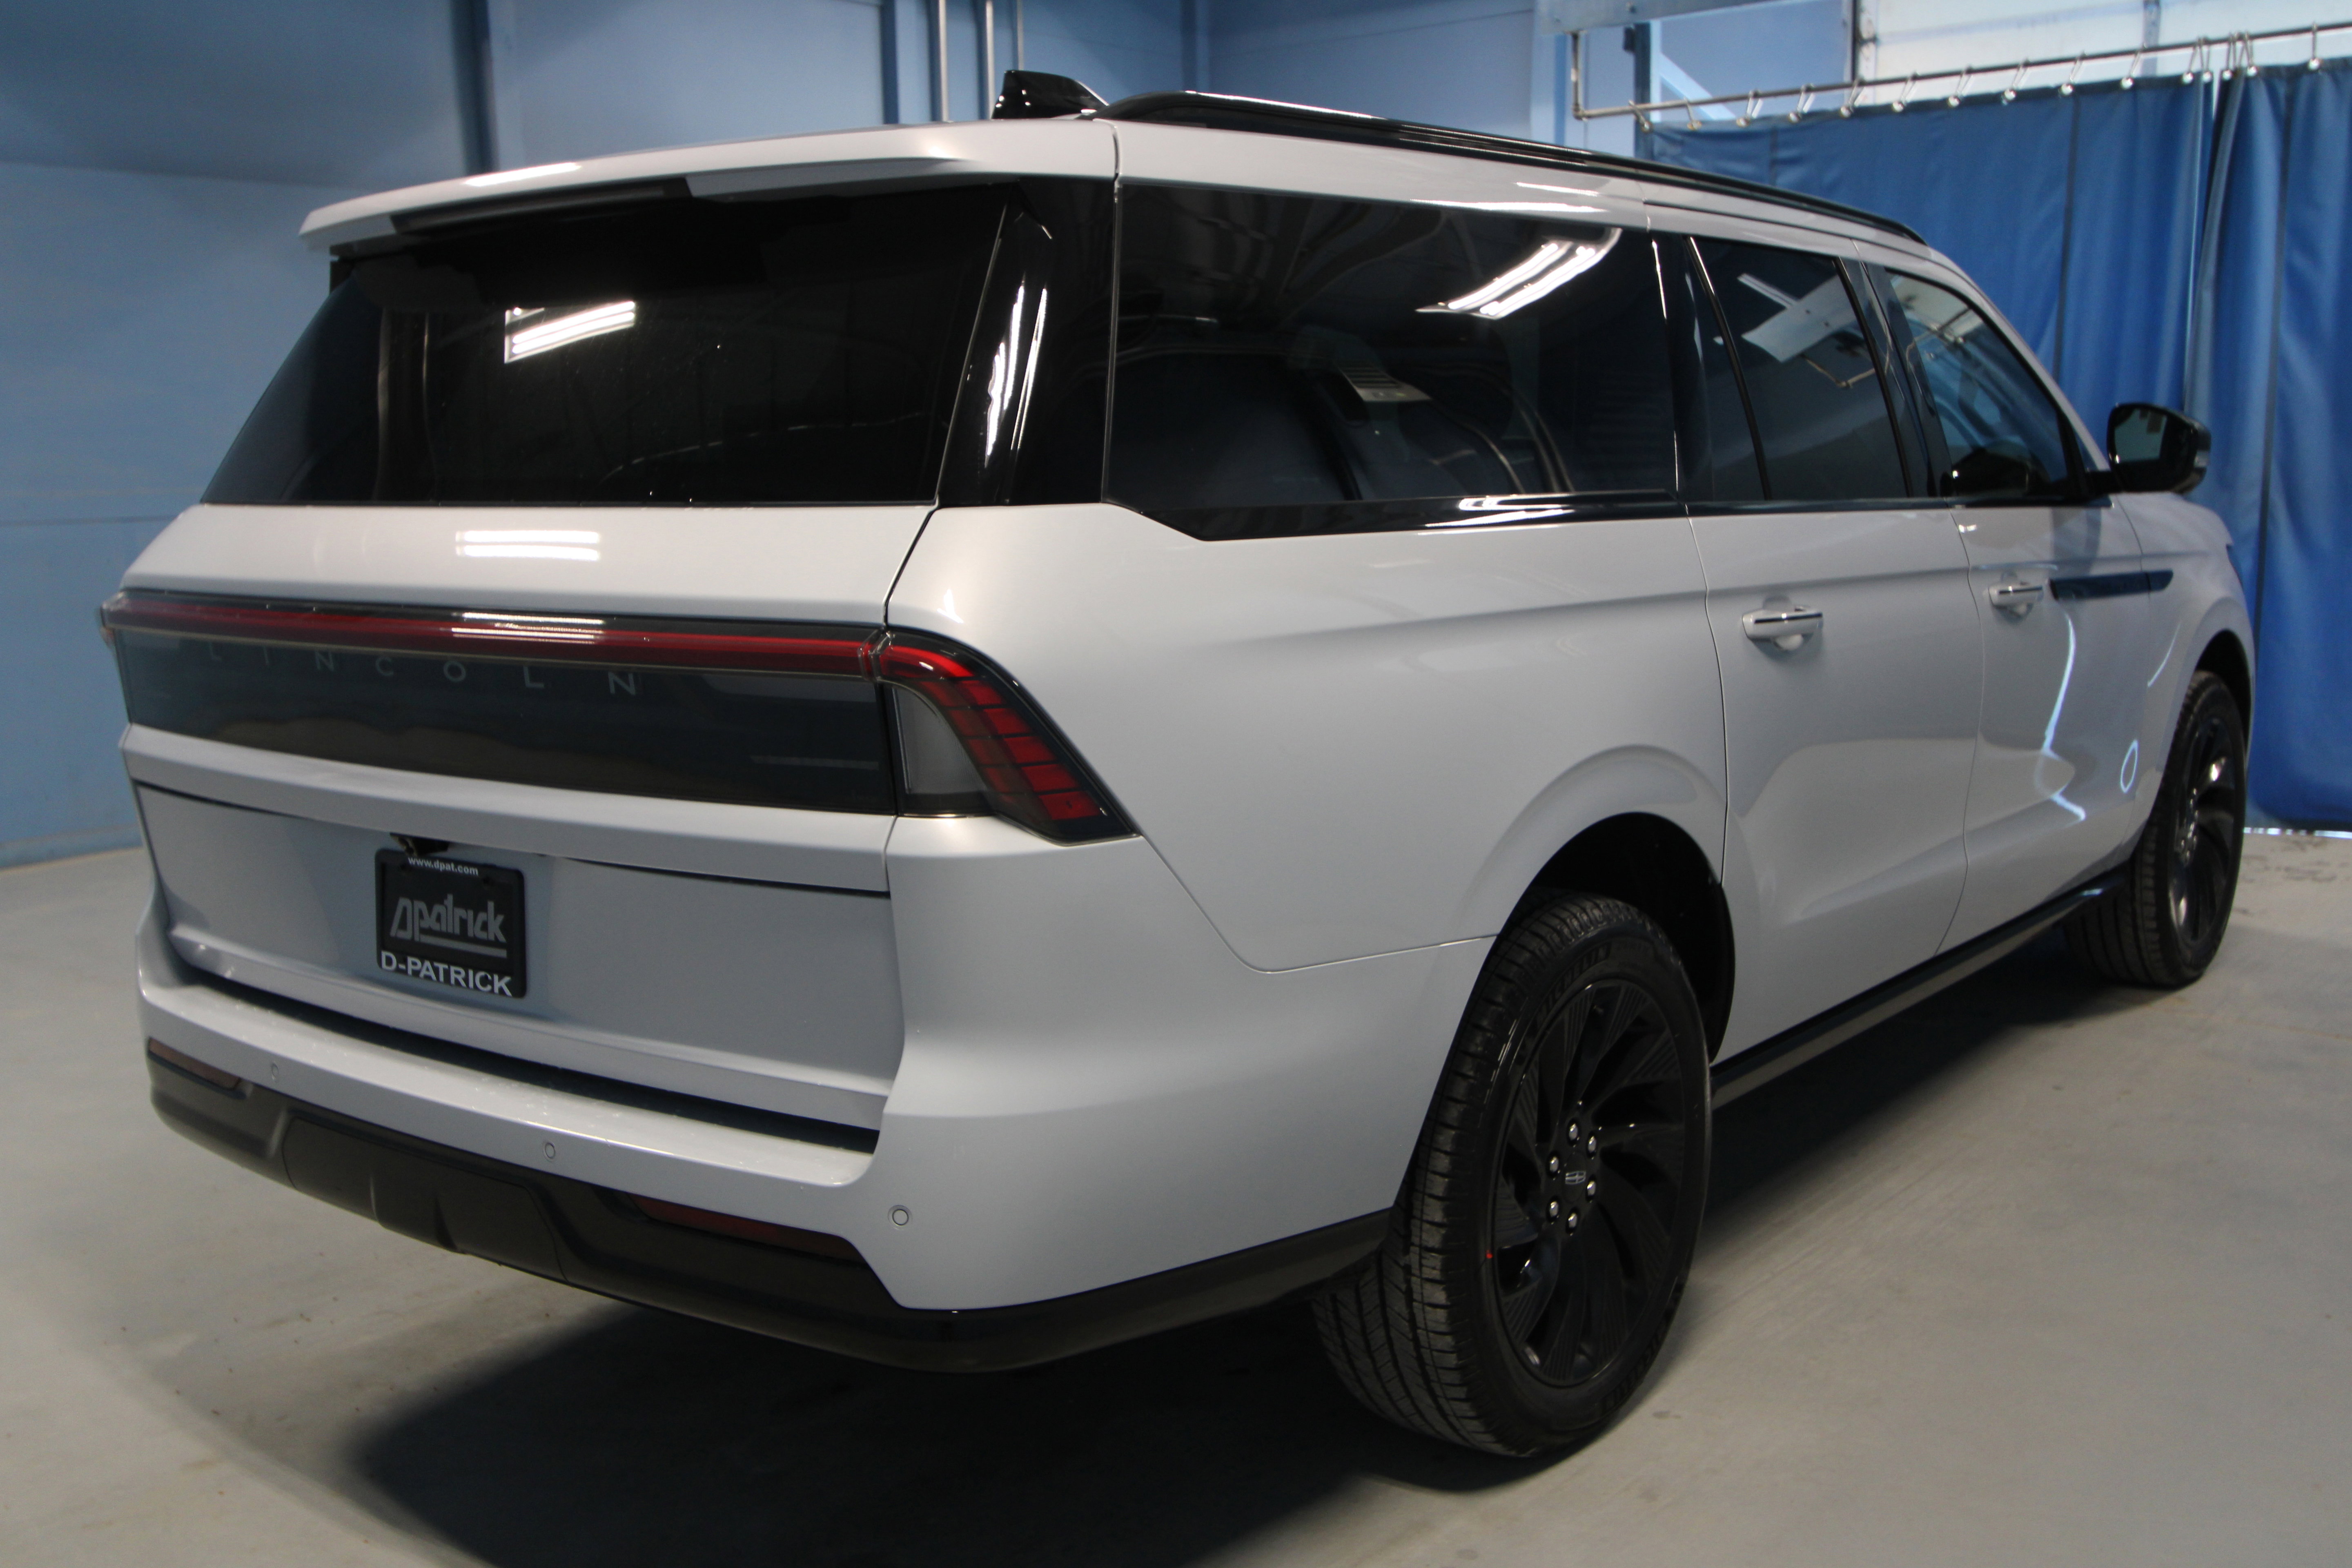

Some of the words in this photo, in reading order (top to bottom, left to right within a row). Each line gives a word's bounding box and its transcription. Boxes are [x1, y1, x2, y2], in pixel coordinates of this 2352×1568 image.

[209, 641, 635, 695] LINCOLN
[408, 858, 478, 875] www.dpat.com
[381, 951, 512, 997] D-PATRICK
